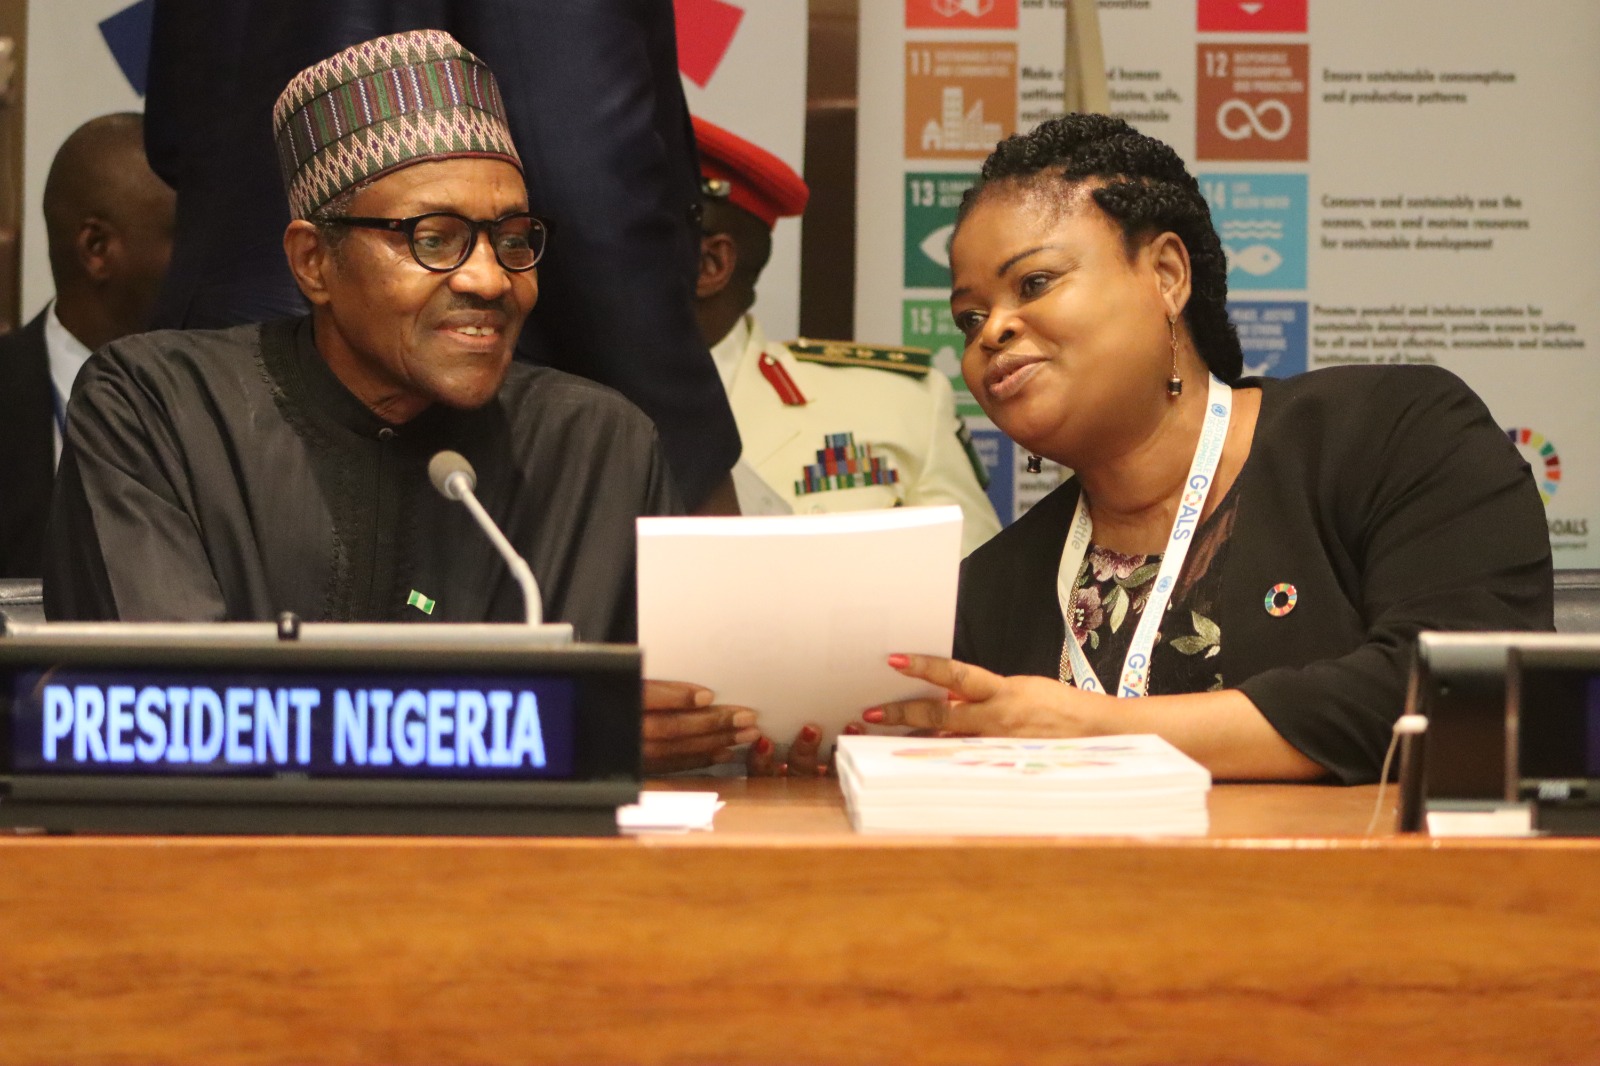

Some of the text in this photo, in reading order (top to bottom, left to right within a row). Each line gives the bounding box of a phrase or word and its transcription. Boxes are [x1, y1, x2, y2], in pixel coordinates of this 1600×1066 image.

[911, 49, 931, 76] 11
[1205, 51, 1229, 77] 12
[911, 180, 935, 207] 13
[1203, 182, 1225, 209] 14
[911, 307, 933, 334] 15
[1193, 415, 1216, 472] DEVELOPMENT
[1202, 418, 1227, 474] SUSTAINABLE
[1172, 474, 1209, 541] GOALS
[1122, 653, 1147, 697] GOA
[42, 685, 547, 767] PRESIDENT NIGERIA
